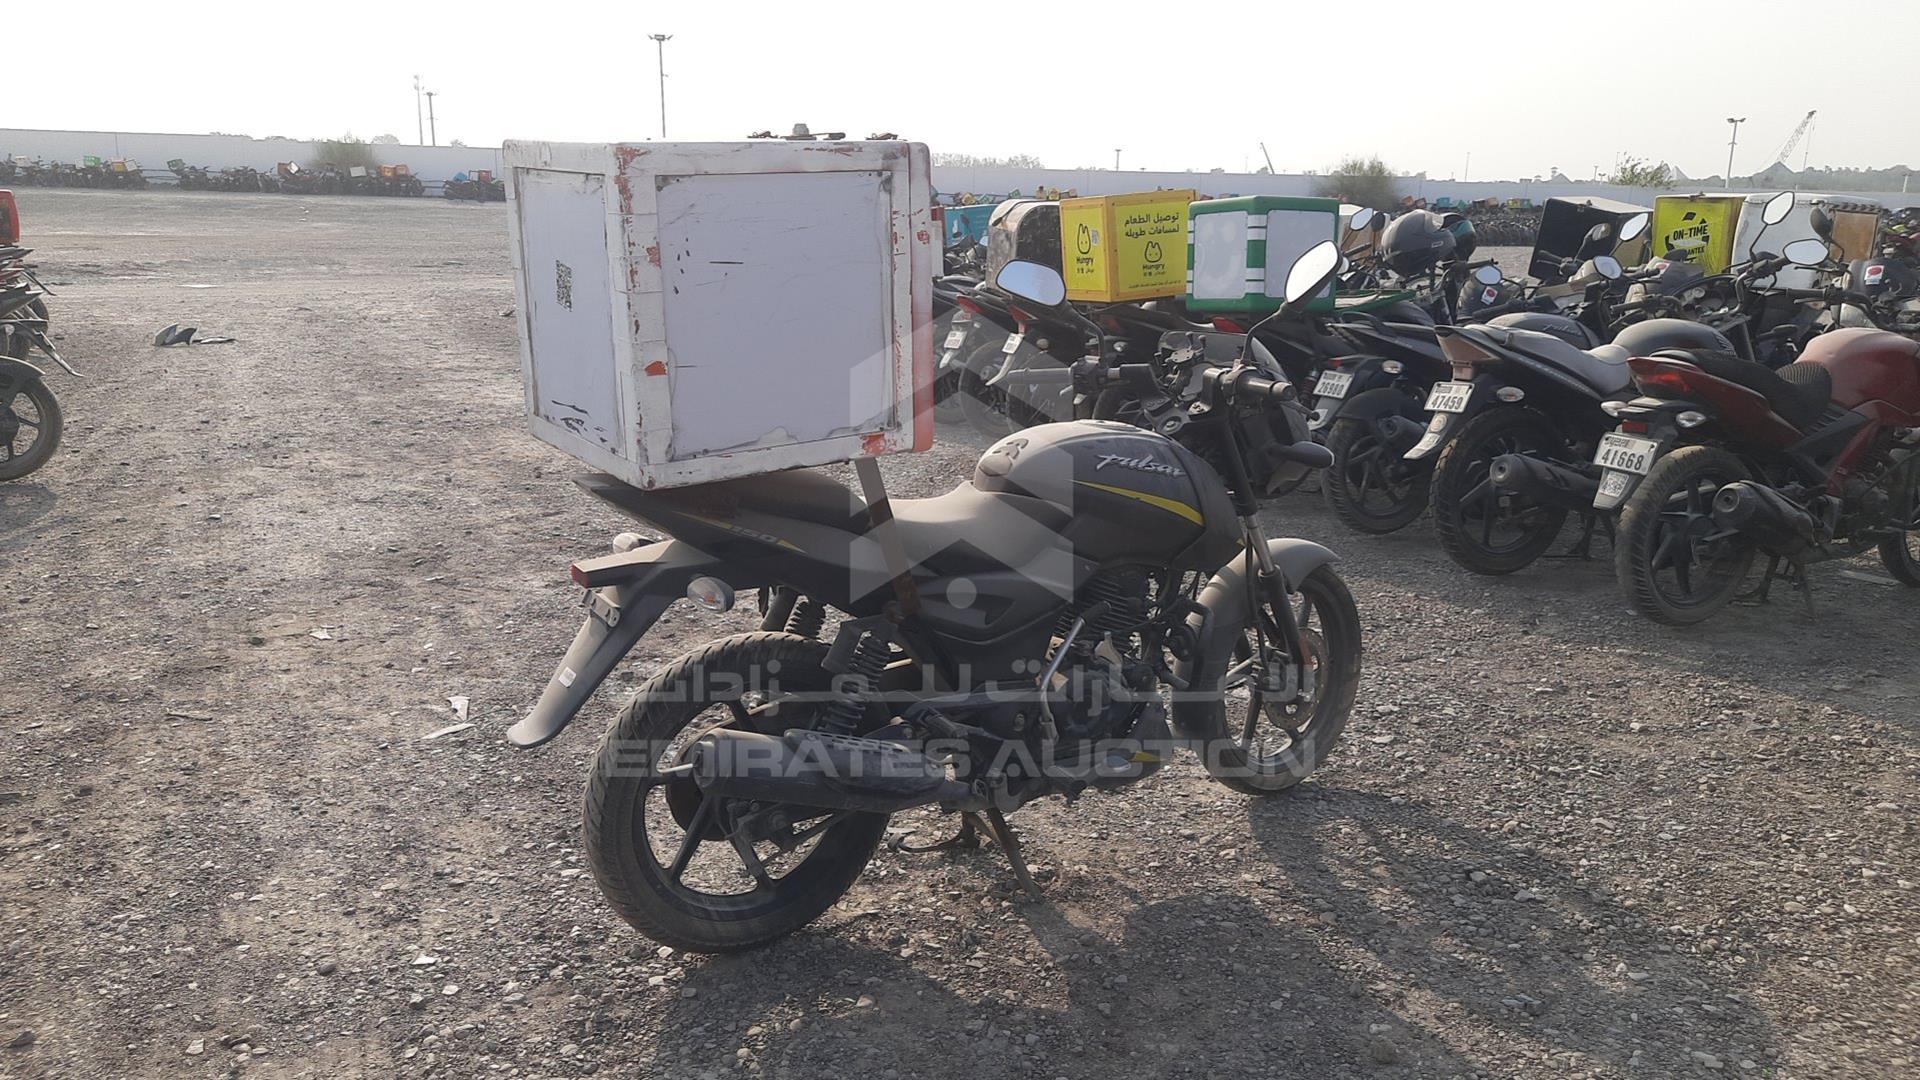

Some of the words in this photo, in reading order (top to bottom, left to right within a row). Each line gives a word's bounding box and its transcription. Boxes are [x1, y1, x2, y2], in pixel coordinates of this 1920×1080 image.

[1124, 214, 1151, 227] الطعام
[1153, 212, 1180, 224] توصيل
[1148, 224, 1179, 235] لمسافات
[1673, 225, 1707, 240] ON-TIME
[1431, 395, 1464, 410] 47459
[1601, 448, 1645, 471] 41668
